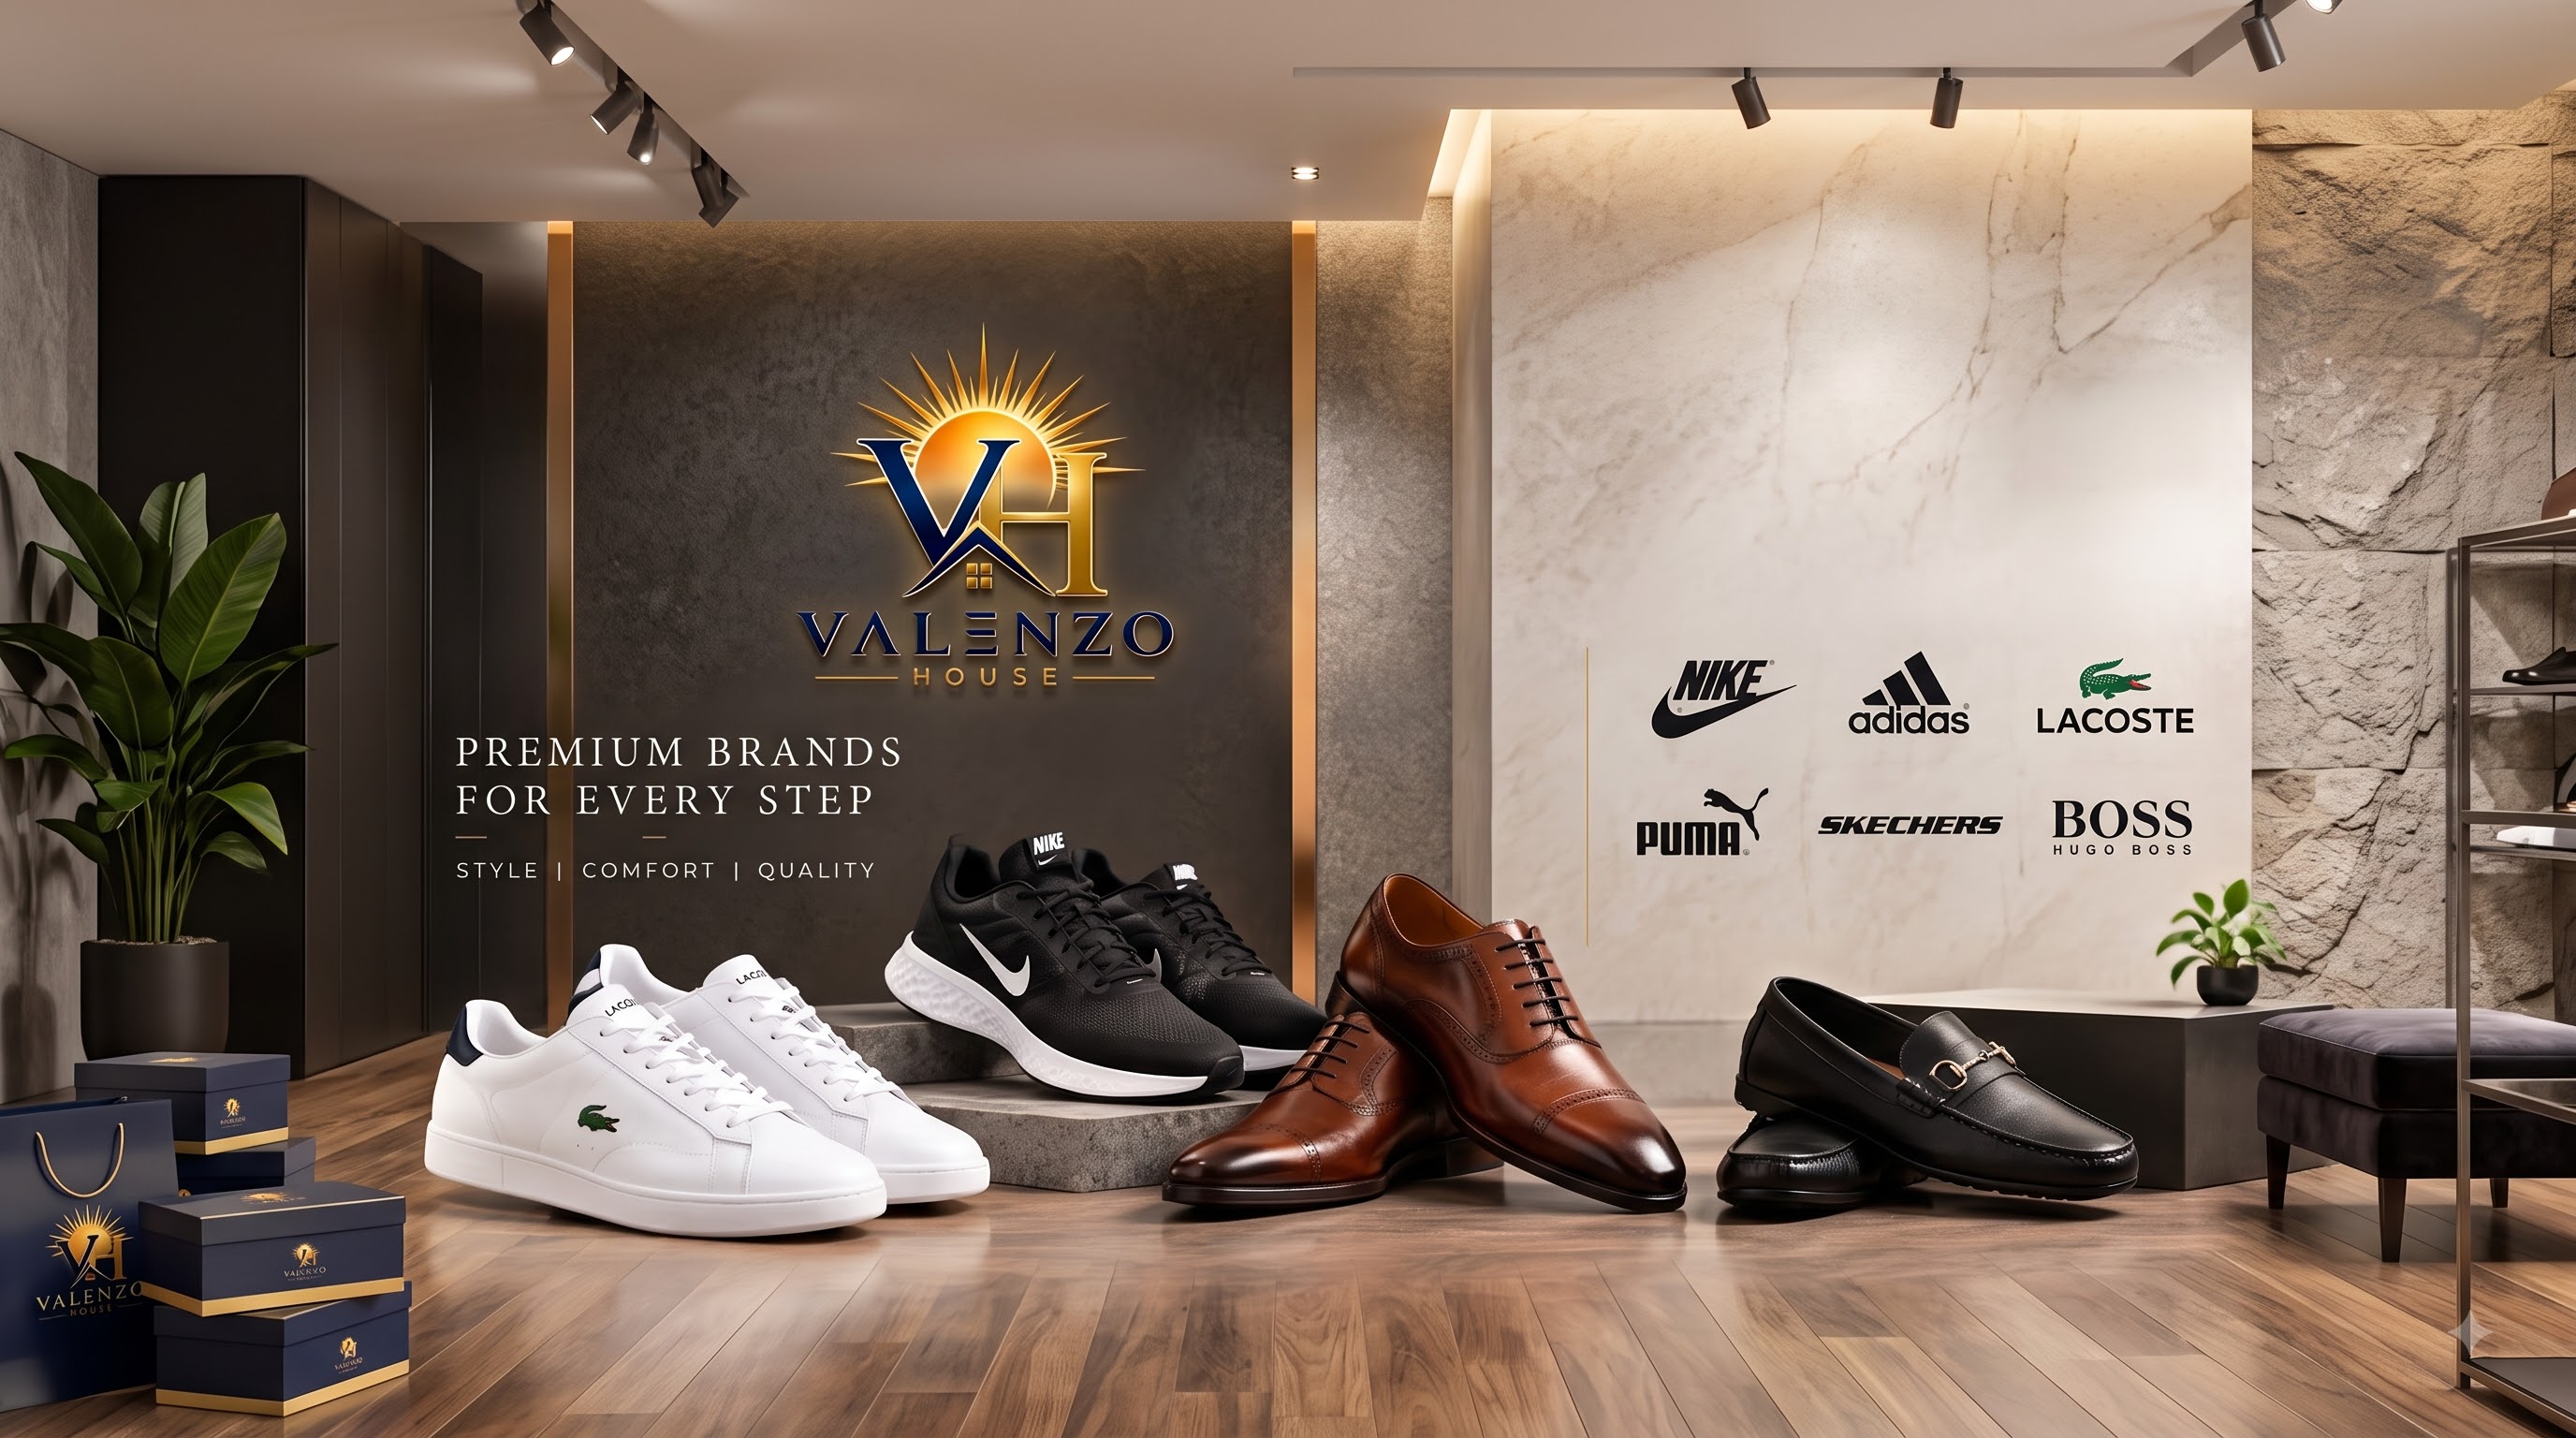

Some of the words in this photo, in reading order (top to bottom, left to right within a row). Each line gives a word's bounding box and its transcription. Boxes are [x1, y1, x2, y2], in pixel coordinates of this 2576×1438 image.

[797, 610, 1175, 657] VALENZO
[914, 668, 1058, 686] HOUSE
[1673, 659, 1768, 701] NIKE
[1848, 705, 1970, 735] adidas
[2037, 708, 2194, 734] LACOSTE
[1818, 815, 2003, 835] SKECHERS
[2052, 800, 2193, 839] BOSS
[1032, 831, 1065, 856] NIKE
[1636, 821, 1740, 856] PUMA
[2053, 844, 2115, 856] HUGO
[2132, 844, 2191, 856] BOSS
[36, 1281, 142, 1312] VALENZO
